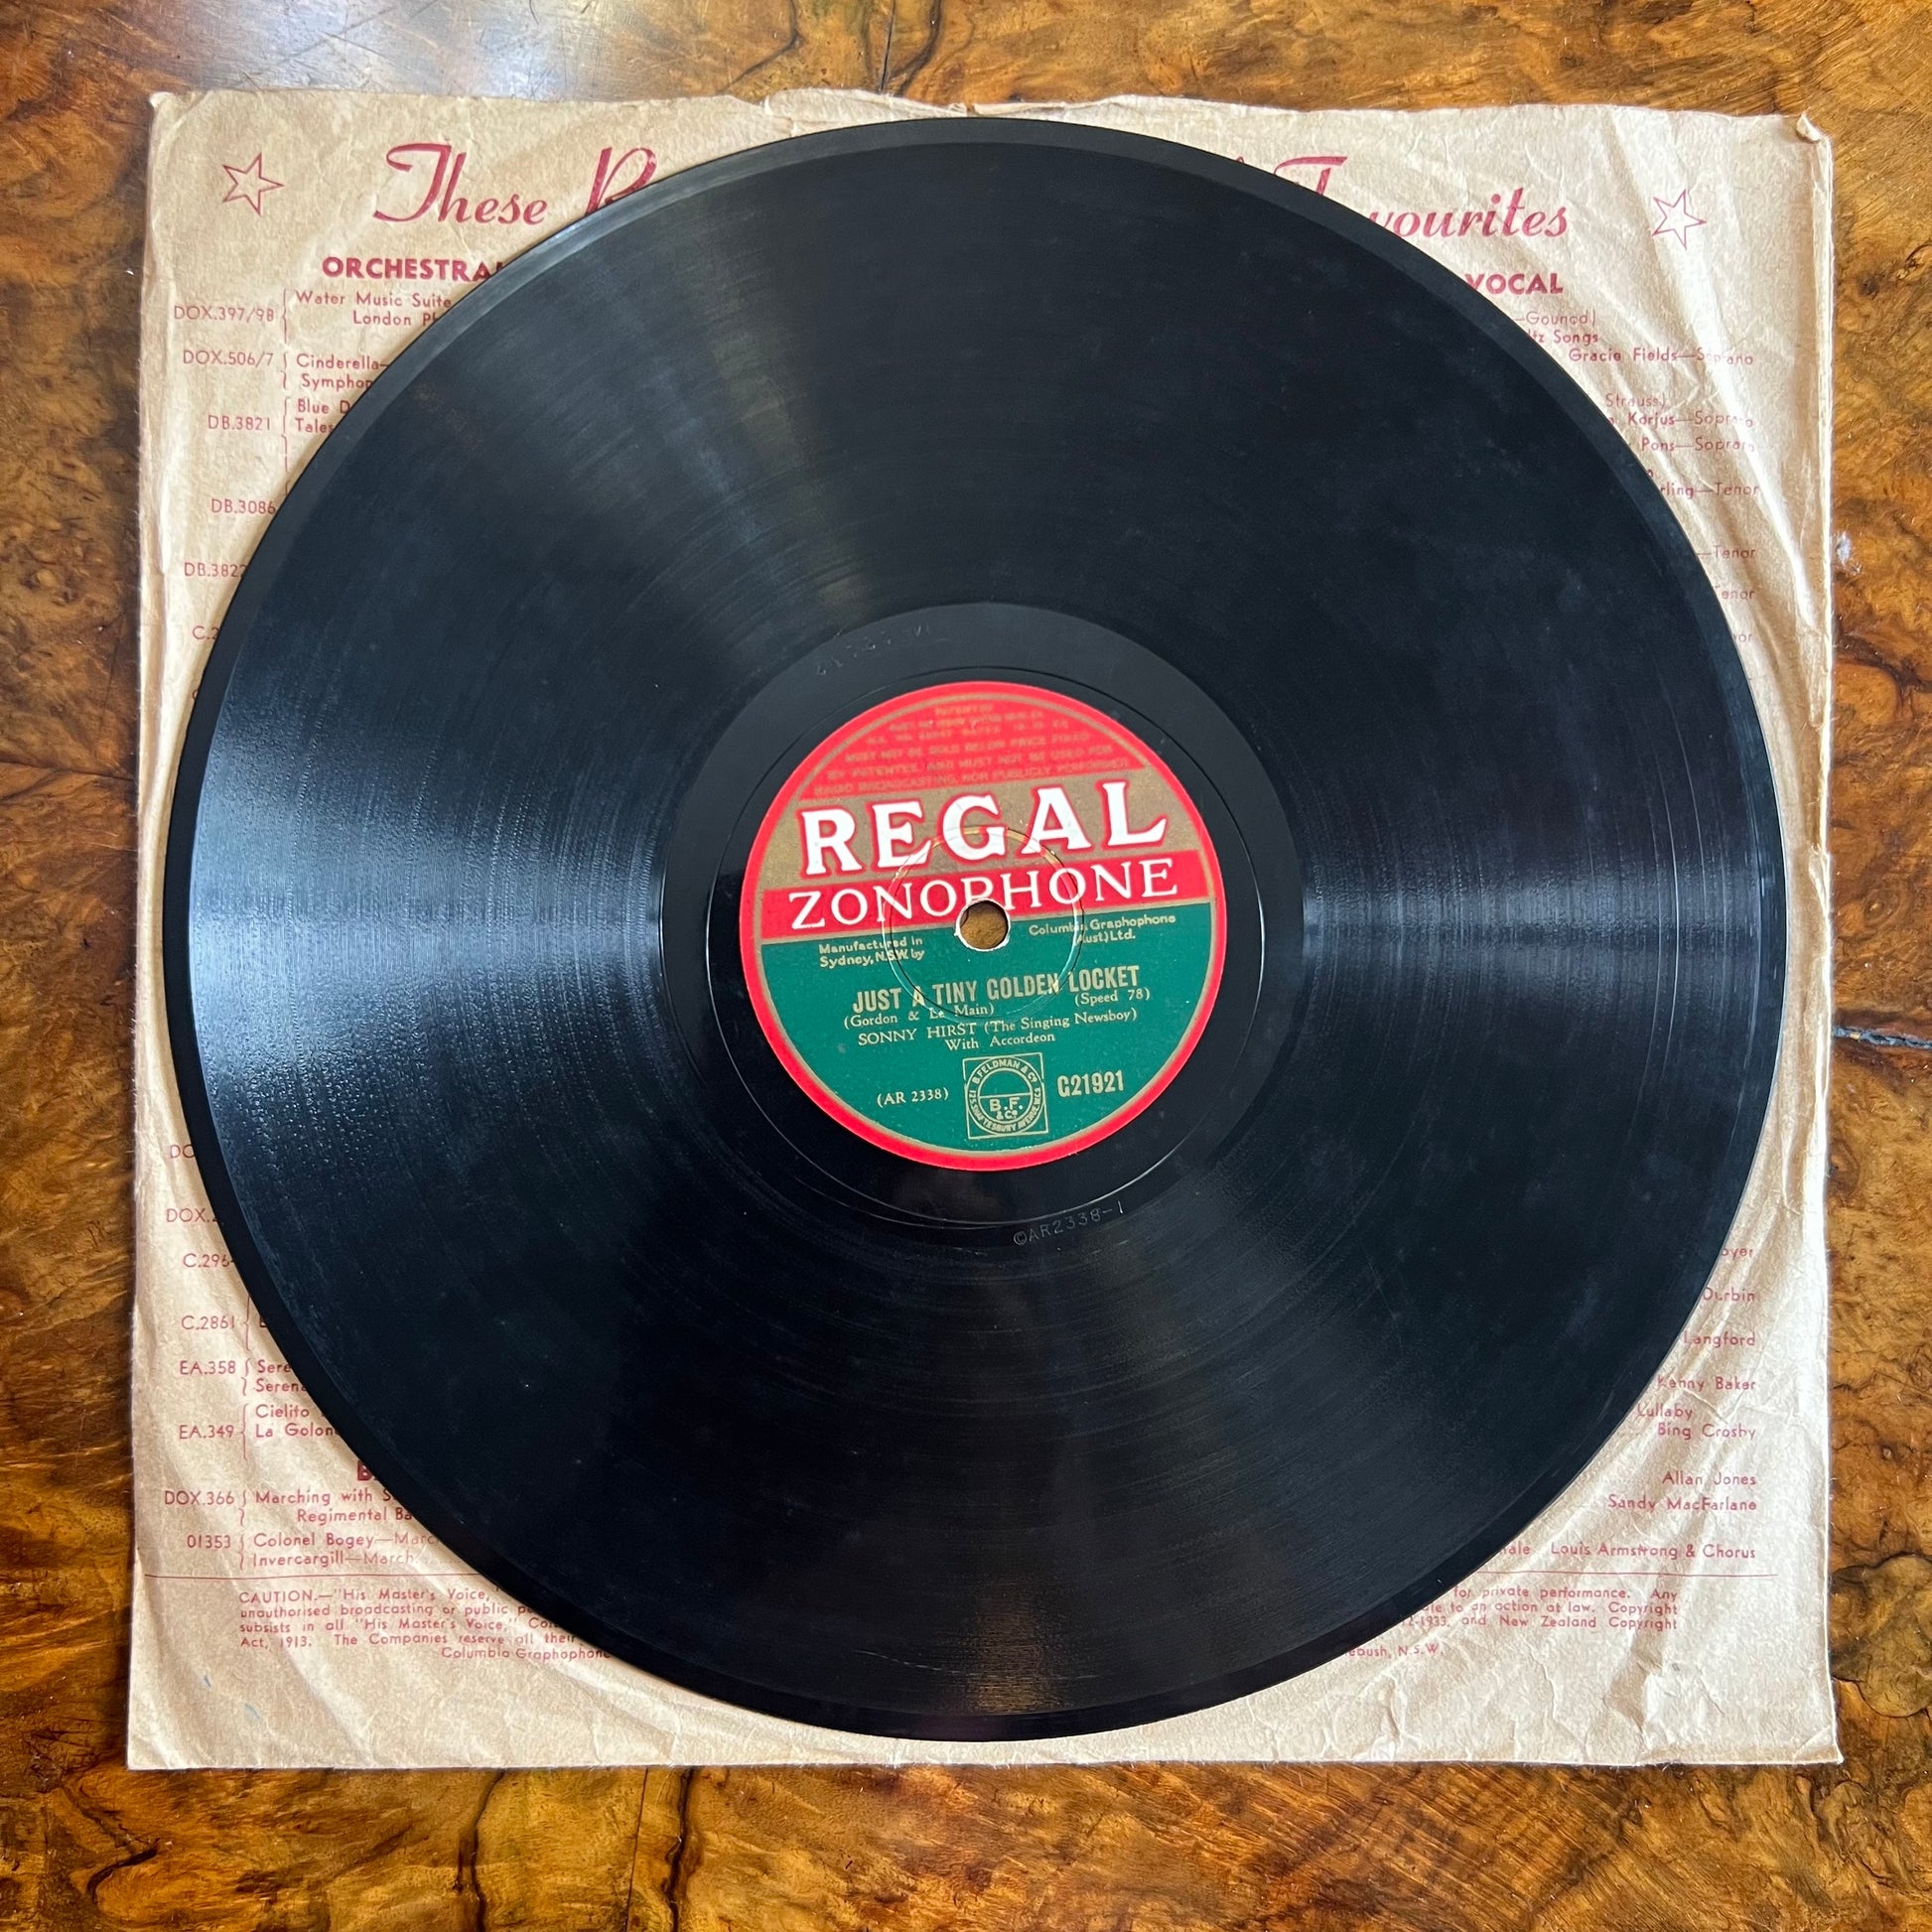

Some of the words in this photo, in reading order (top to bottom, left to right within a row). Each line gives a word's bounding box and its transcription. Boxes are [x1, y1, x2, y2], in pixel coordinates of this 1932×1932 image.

[373, 142, 547, 225] These
[322, 255, 506, 283] ORCHESTRA
[1464, 273, 1564, 295] VOCAL
[296, 290, 345, 306] Water
[356, 292, 402, 307] Music
[412, 292, 452, 309] Suite
[174, 305, 275, 323] DOX.397/98
[352, 311, 412, 327] London
[1553, 330, 1599, 345] Songs
[183, 349, 274, 367] DOX.506/7
[1569, 348, 1621, 362] Gracie
[298, 398, 330, 414] Blue
[207, 415, 271, 431] DB.3821
[211, 498, 277, 515] DB.3086
[800, 780, 1168, 876] REGAL
[788, 858, 1178, 930] ZONOPHONE
[1089, 913, 1176, 931] Graphophone
[1110, 928, 1137, 941] Ltd.
[819, 936, 907, 954] Manufactured
[911, 936, 923, 945] in
[910, 947, 925, 960] by
[852, 987, 902, 1014] JUST
[911, 986, 926, 1008] A
[932, 980, 977, 1006] TINY
[986, 973, 1059, 1001] GOLDEN
[1067, 965, 1140, 993] LOCKET
[1074, 990, 1119, 1007] (Speed
[1128, 987, 1151, 1001] 78)
[844, 1013, 898, 1030] (Gordon
[907, 1010, 919, 1021] &
[929, 1007, 945, 1020] Le
[954, 1002, 995, 1018] Main)
[858, 1028, 918, 1046] SONNY
[926, 1022, 977, 1038] HIRST
[984, 1020, 1016, 1035] (The
[1021, 1016, 1070, 1031] Singing
[1074, 1007, 1138, 1025] Newsboy)
[945, 1036, 979, 1051] With
[990, 1032, 1055, 1047] Accordeon
[1056, 1069, 1126, 1099] G21921
[877, 1092, 906, 1108] (AR
[911, 1087, 949, 1103] 2338)
[183, 1253, 235, 1268] C.296
[1722, 1248, 1753, 1260] oyer
[181, 1314, 235, 1330] C.2861
[1684, 1330, 1755, 1348] Langford
[180, 1360, 236, 1375] EA.358
[1657, 1374, 1705, 1392] Kenny
[1715, 1376, 1756, 1390] Baker
[255, 1404, 310, 1419] Cielito
[1638, 1402, 1693, 1420] Lullaby
[179, 1425, 234, 1440] EA.349
[255, 1424, 274, 1439] La
[1658, 1423, 1692, 1440] Bing
[1702, 1423, 1756, 1440] Crosby
[1662, 1470, 1704, 1486] Allan
[1715, 1471, 1756, 1486] Jones
[164, 1490, 235, 1506] DOX.366
[255, 1489, 332, 1506] Marching
[341, 1488, 373, 1503] with
[1607, 1493, 1656, 1511] Sandy
[1667, 1496, 1757, 1511] MacFarlane
[298, 1507, 387, 1526] Regimental
[187, 1534, 231, 1549] 01353
[253, 1532, 315, 1547] Colonel
[1551, 1542, 1590, 1556] Louis
[1597, 1543, 1678, 1560] Armstrong
[1685, 1545, 1696, 1558] &
[1703, 1543, 1756, 1559] Chorus
[378, 1588, 436, 1601] Master's
[1452, 1587, 1471, 1597] for
[1482, 1586, 1529, 1598] private
[1540, 1586, 1631, 1599] performance.
[1651, 1588, 1678, 1602] Any
[240, 1604, 331, 1618] unauthorised
[341, 1602, 433, 1617] broadcasting
[443, 1605, 455, 1615] or
[465, 1602, 508, 1617] public
[1450, 1602, 1462, 1612] to
[1495, 1601, 1538, 1612] action
[1547, 1602, 1561, 1612] at
[1568, 1601, 1595, 1613] law.
[1608, 1601, 1678, 1615] Copyright
[240, 1620, 291, 1633] subsists
[303, 1622, 315, 1631] in
[326, 1618, 344, 1631] all
[399, 1617, 456, 1630] Master's
[1461, 1614, 1486, 1626] and
[1500, 1616, 1528, 1627] New
[1541, 1615, 1596, 1628] Zealand
[1608, 1616, 1678, 1631] Copyright
[240, 1637, 269, 1650] Act,
[280, 1636, 313, 1648] 1913.
[335, 1633, 358, 1645] The
[369, 1632, 448, 1646] Companies
[459, 1634, 505, 1644] reserve
[515, 1631, 534, 1644] all
[441, 1647, 510, 1659] Columbia
